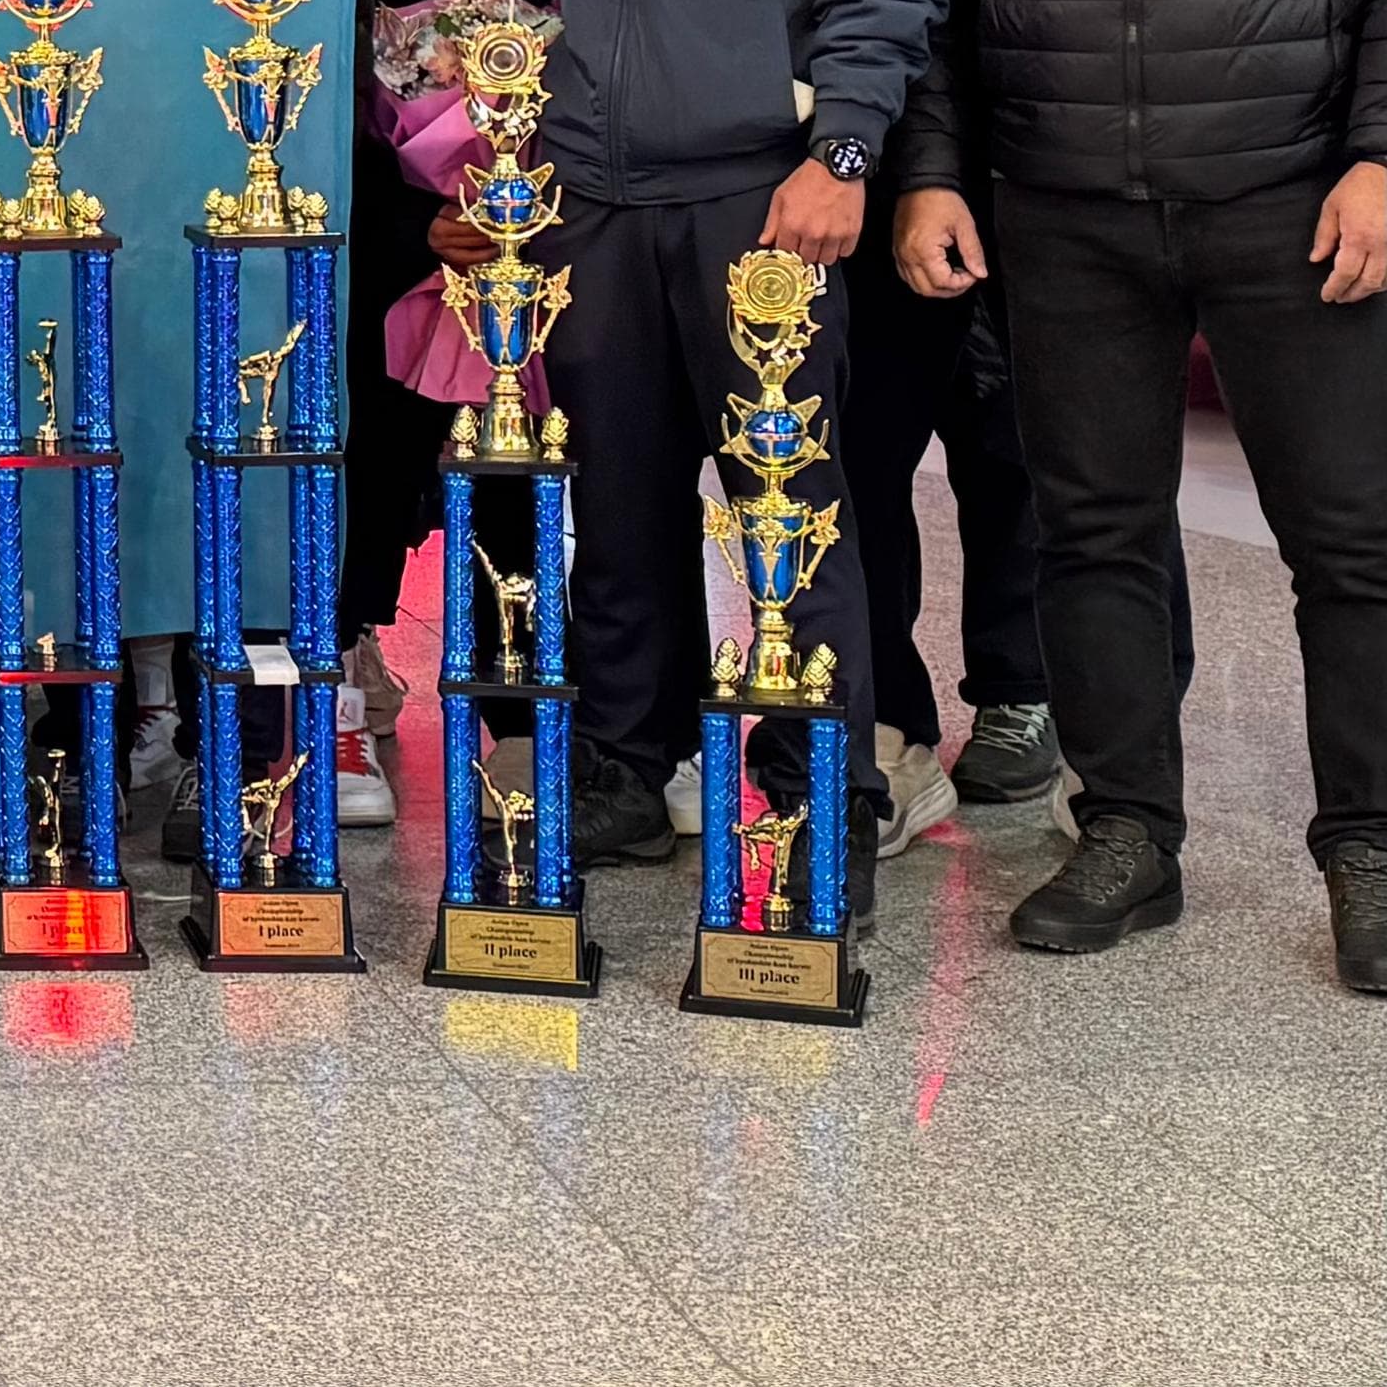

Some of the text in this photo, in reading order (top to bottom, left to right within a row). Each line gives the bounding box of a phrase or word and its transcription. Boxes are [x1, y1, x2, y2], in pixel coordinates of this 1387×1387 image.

[259, 925, 303, 939] I place
[485, 943, 537, 959] II place
[739, 968, 799, 984] III place
